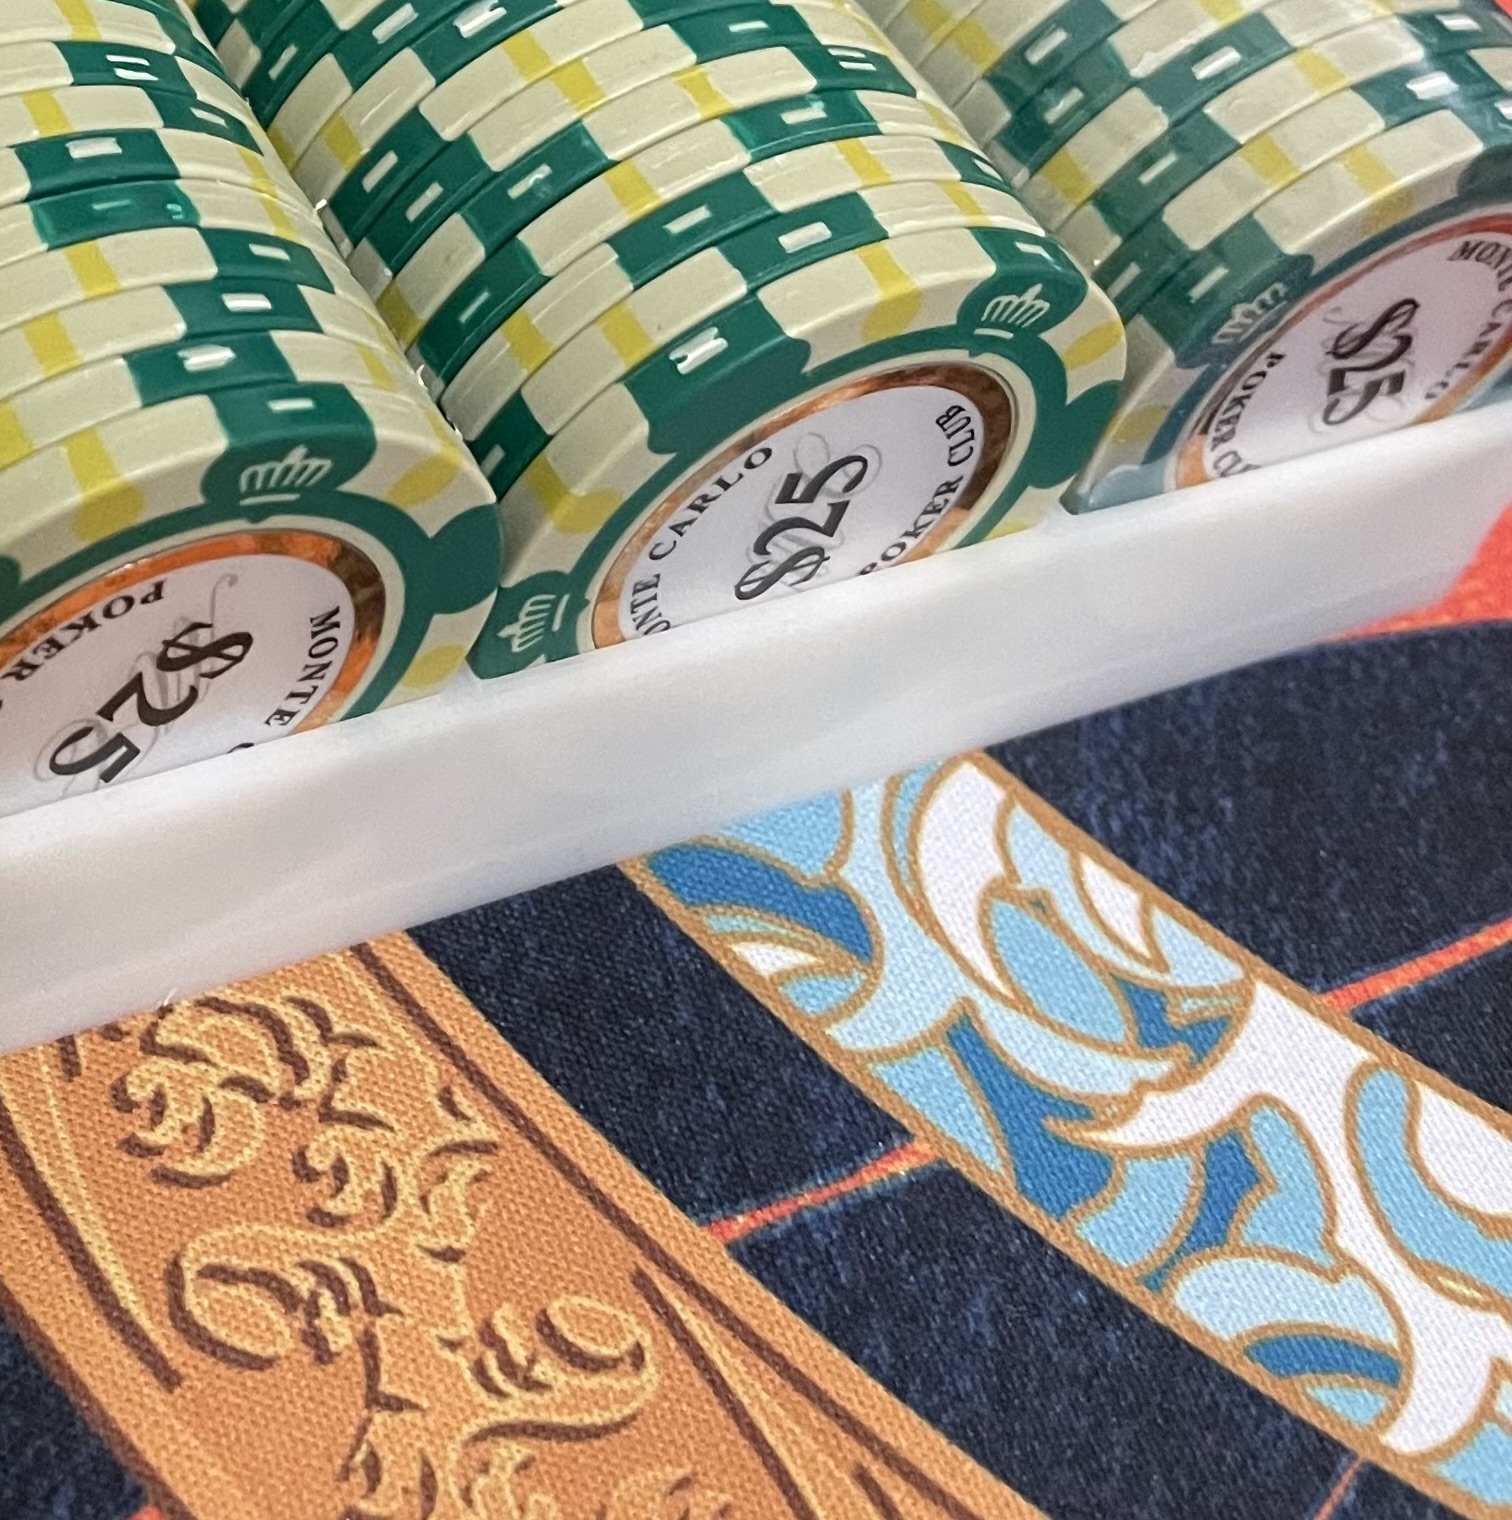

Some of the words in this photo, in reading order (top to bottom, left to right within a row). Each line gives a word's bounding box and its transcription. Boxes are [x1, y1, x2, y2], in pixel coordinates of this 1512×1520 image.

[1323, 297, 1421, 426] $25
[934, 403, 980, 467] CLUB
[647, 445, 773, 561] CARLO
[733, 454, 869, 601] $25
[1, 578, 168, 682] POKER
[630, 572, 671, 636] ONTE
[48, 622, 255, 784] $25
[263, 605, 341, 728] MONTE
